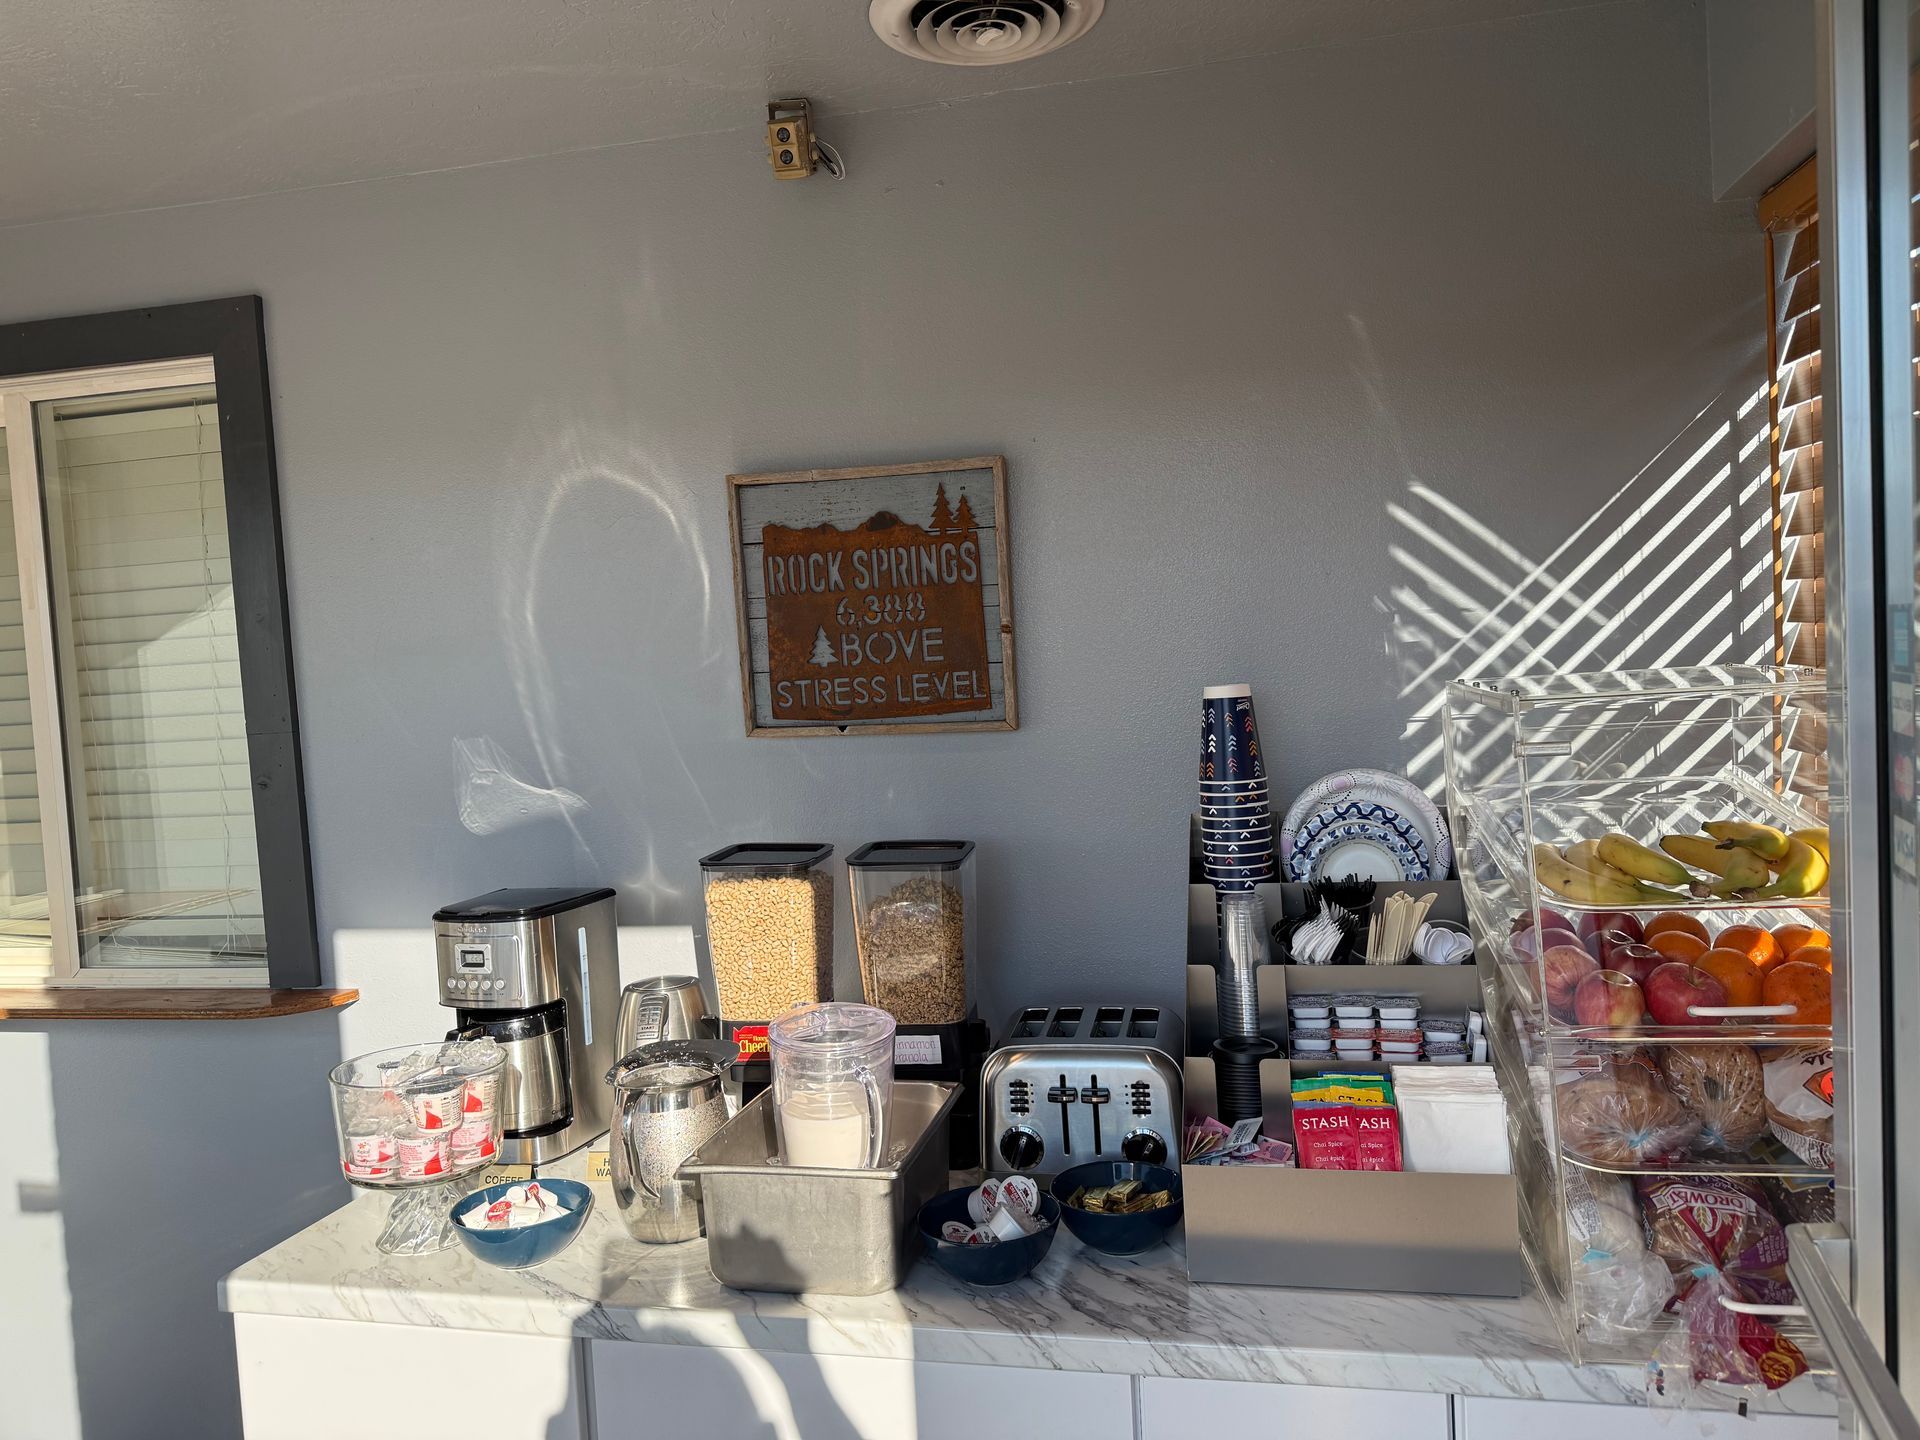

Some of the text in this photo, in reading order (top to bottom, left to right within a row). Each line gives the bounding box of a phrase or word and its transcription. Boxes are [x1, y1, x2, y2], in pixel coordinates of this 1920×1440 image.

[767, 540, 978, 596] ROCK SPRINGS
[776, 669, 987, 709] STRESS LEVEL
[739, 1039, 771, 1053] Cheeri
[896, 1040, 936, 1050] innamon
[895, 1051, 928, 1063] ranola
[1302, 1115, 1349, 1130] STASH
[1356, 1117, 1391, 1129] ASH
